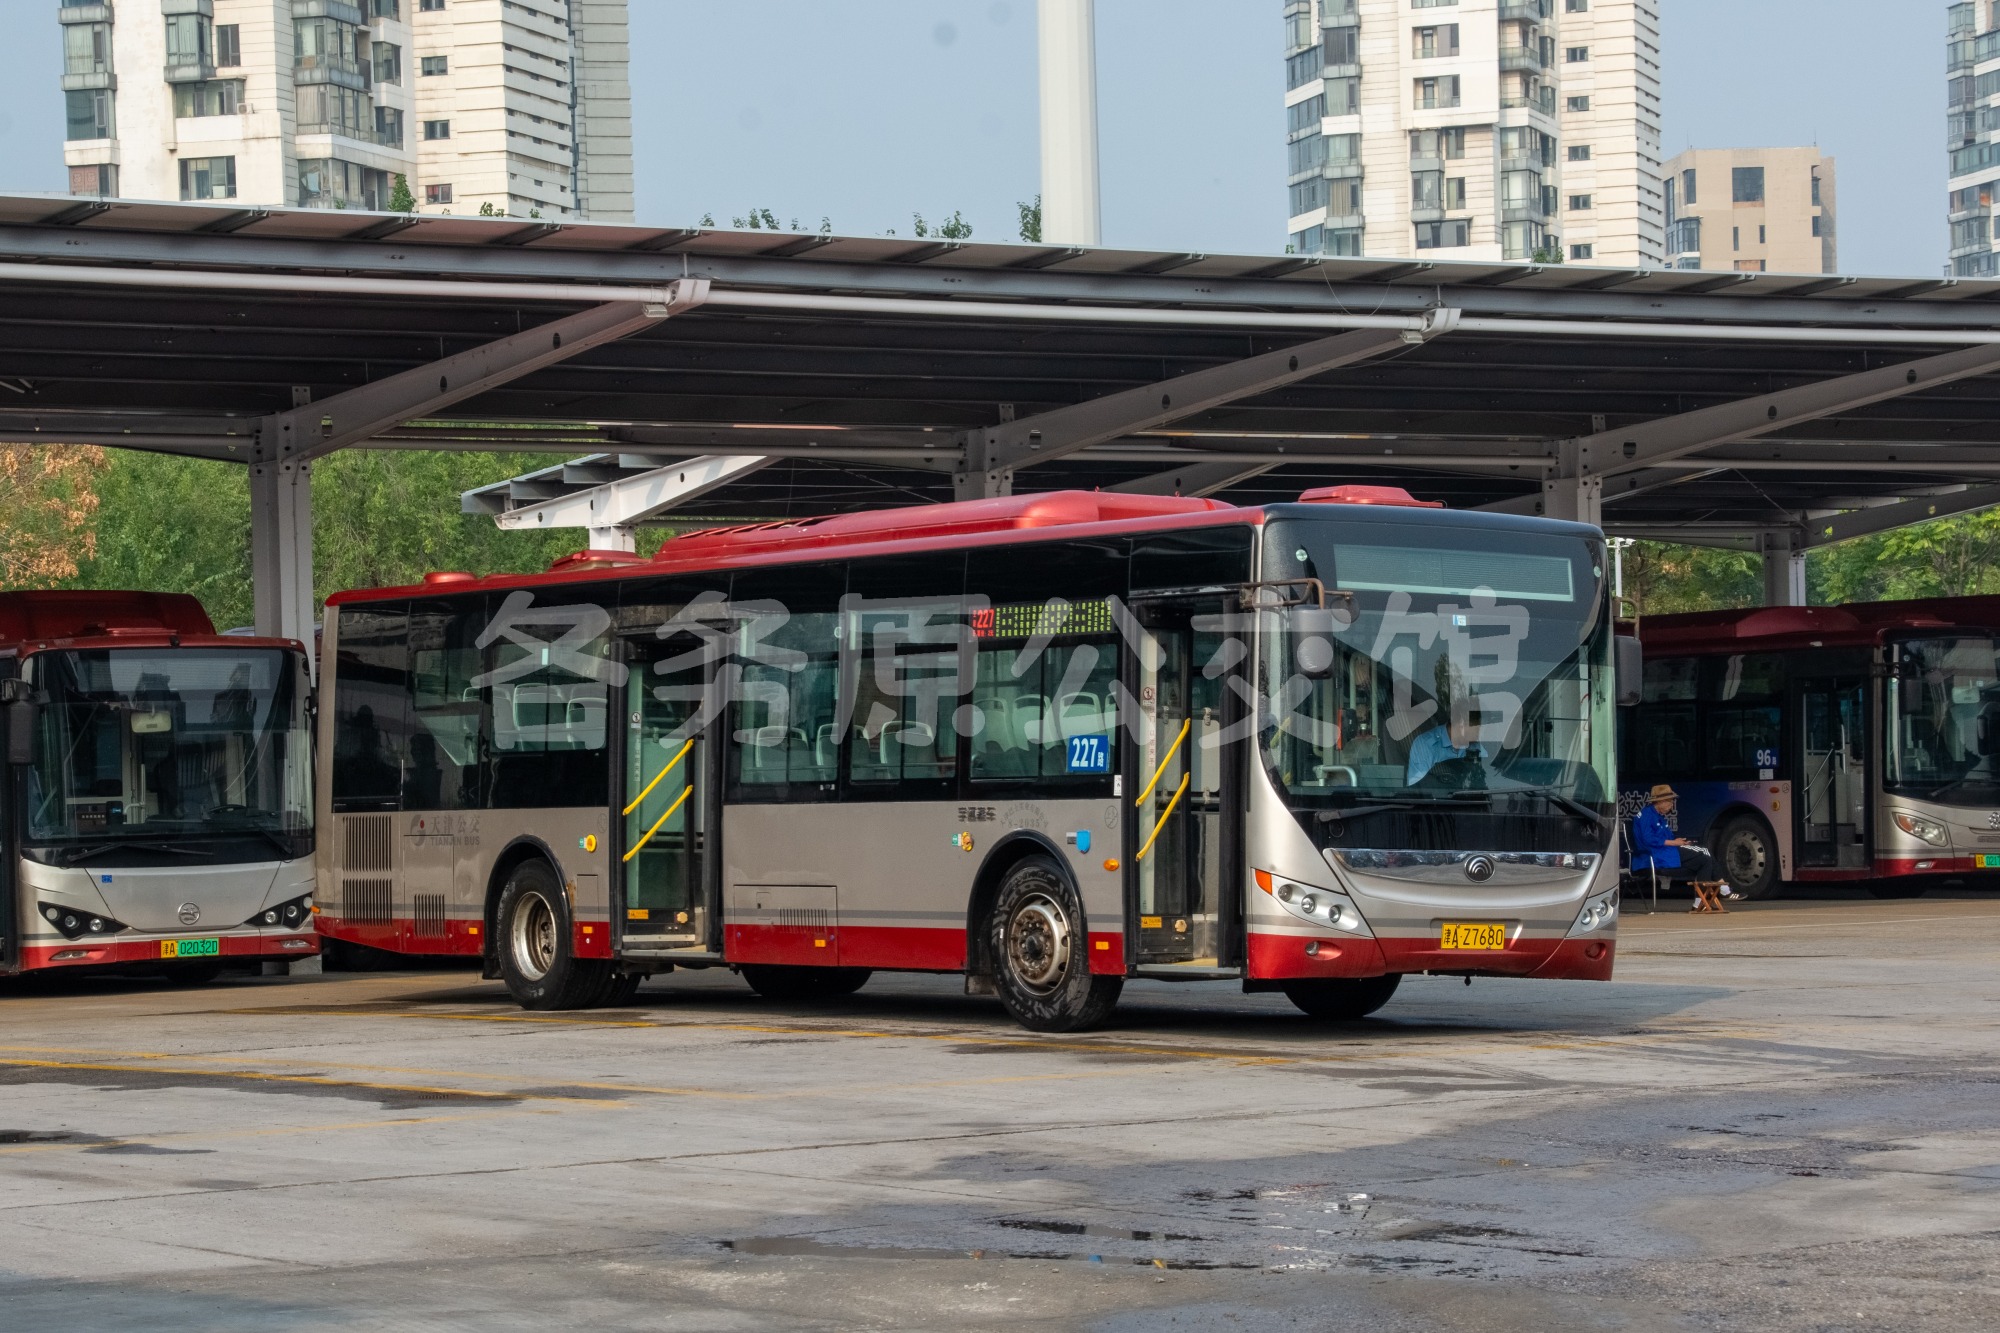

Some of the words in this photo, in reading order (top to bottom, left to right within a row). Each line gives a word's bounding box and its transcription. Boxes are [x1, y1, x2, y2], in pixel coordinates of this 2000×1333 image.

[977, 609, 995, 628] 227
[430, 815, 480, 834] 天津公交
[430, 837, 462, 847] TIANJIN
[465, 836, 480, 846] BUS
